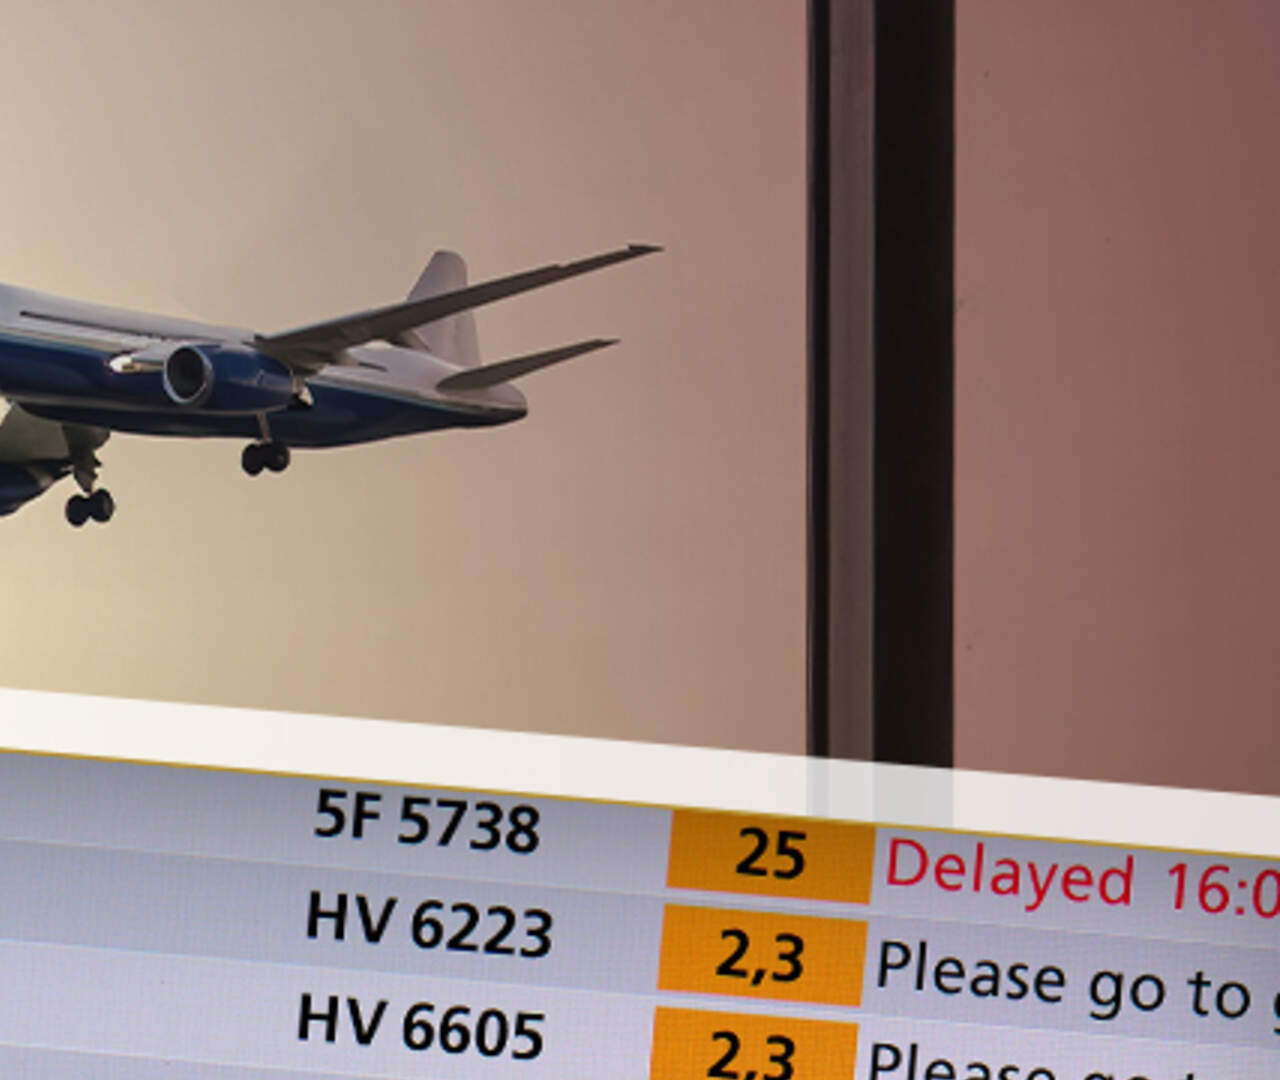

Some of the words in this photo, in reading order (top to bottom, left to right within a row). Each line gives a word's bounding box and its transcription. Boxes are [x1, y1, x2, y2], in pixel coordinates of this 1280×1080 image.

[314, 787, 383, 839] 5F
[397, 795, 541, 855] 5738
[735, 825, 808, 881] 25
[886, 836, 1135, 912] Delayed
[306, 889, 399, 944] HV
[411, 899, 554, 959] 6223
[715, 928, 805, 988] 2,3
[877, 939, 1067, 1004] Please
[1089, 970, 1167, 1022] go
[1186, 970, 1252, 1020] to
[297, 992, 389, 1046] HV
[402, 1002, 545, 1061] 6605
